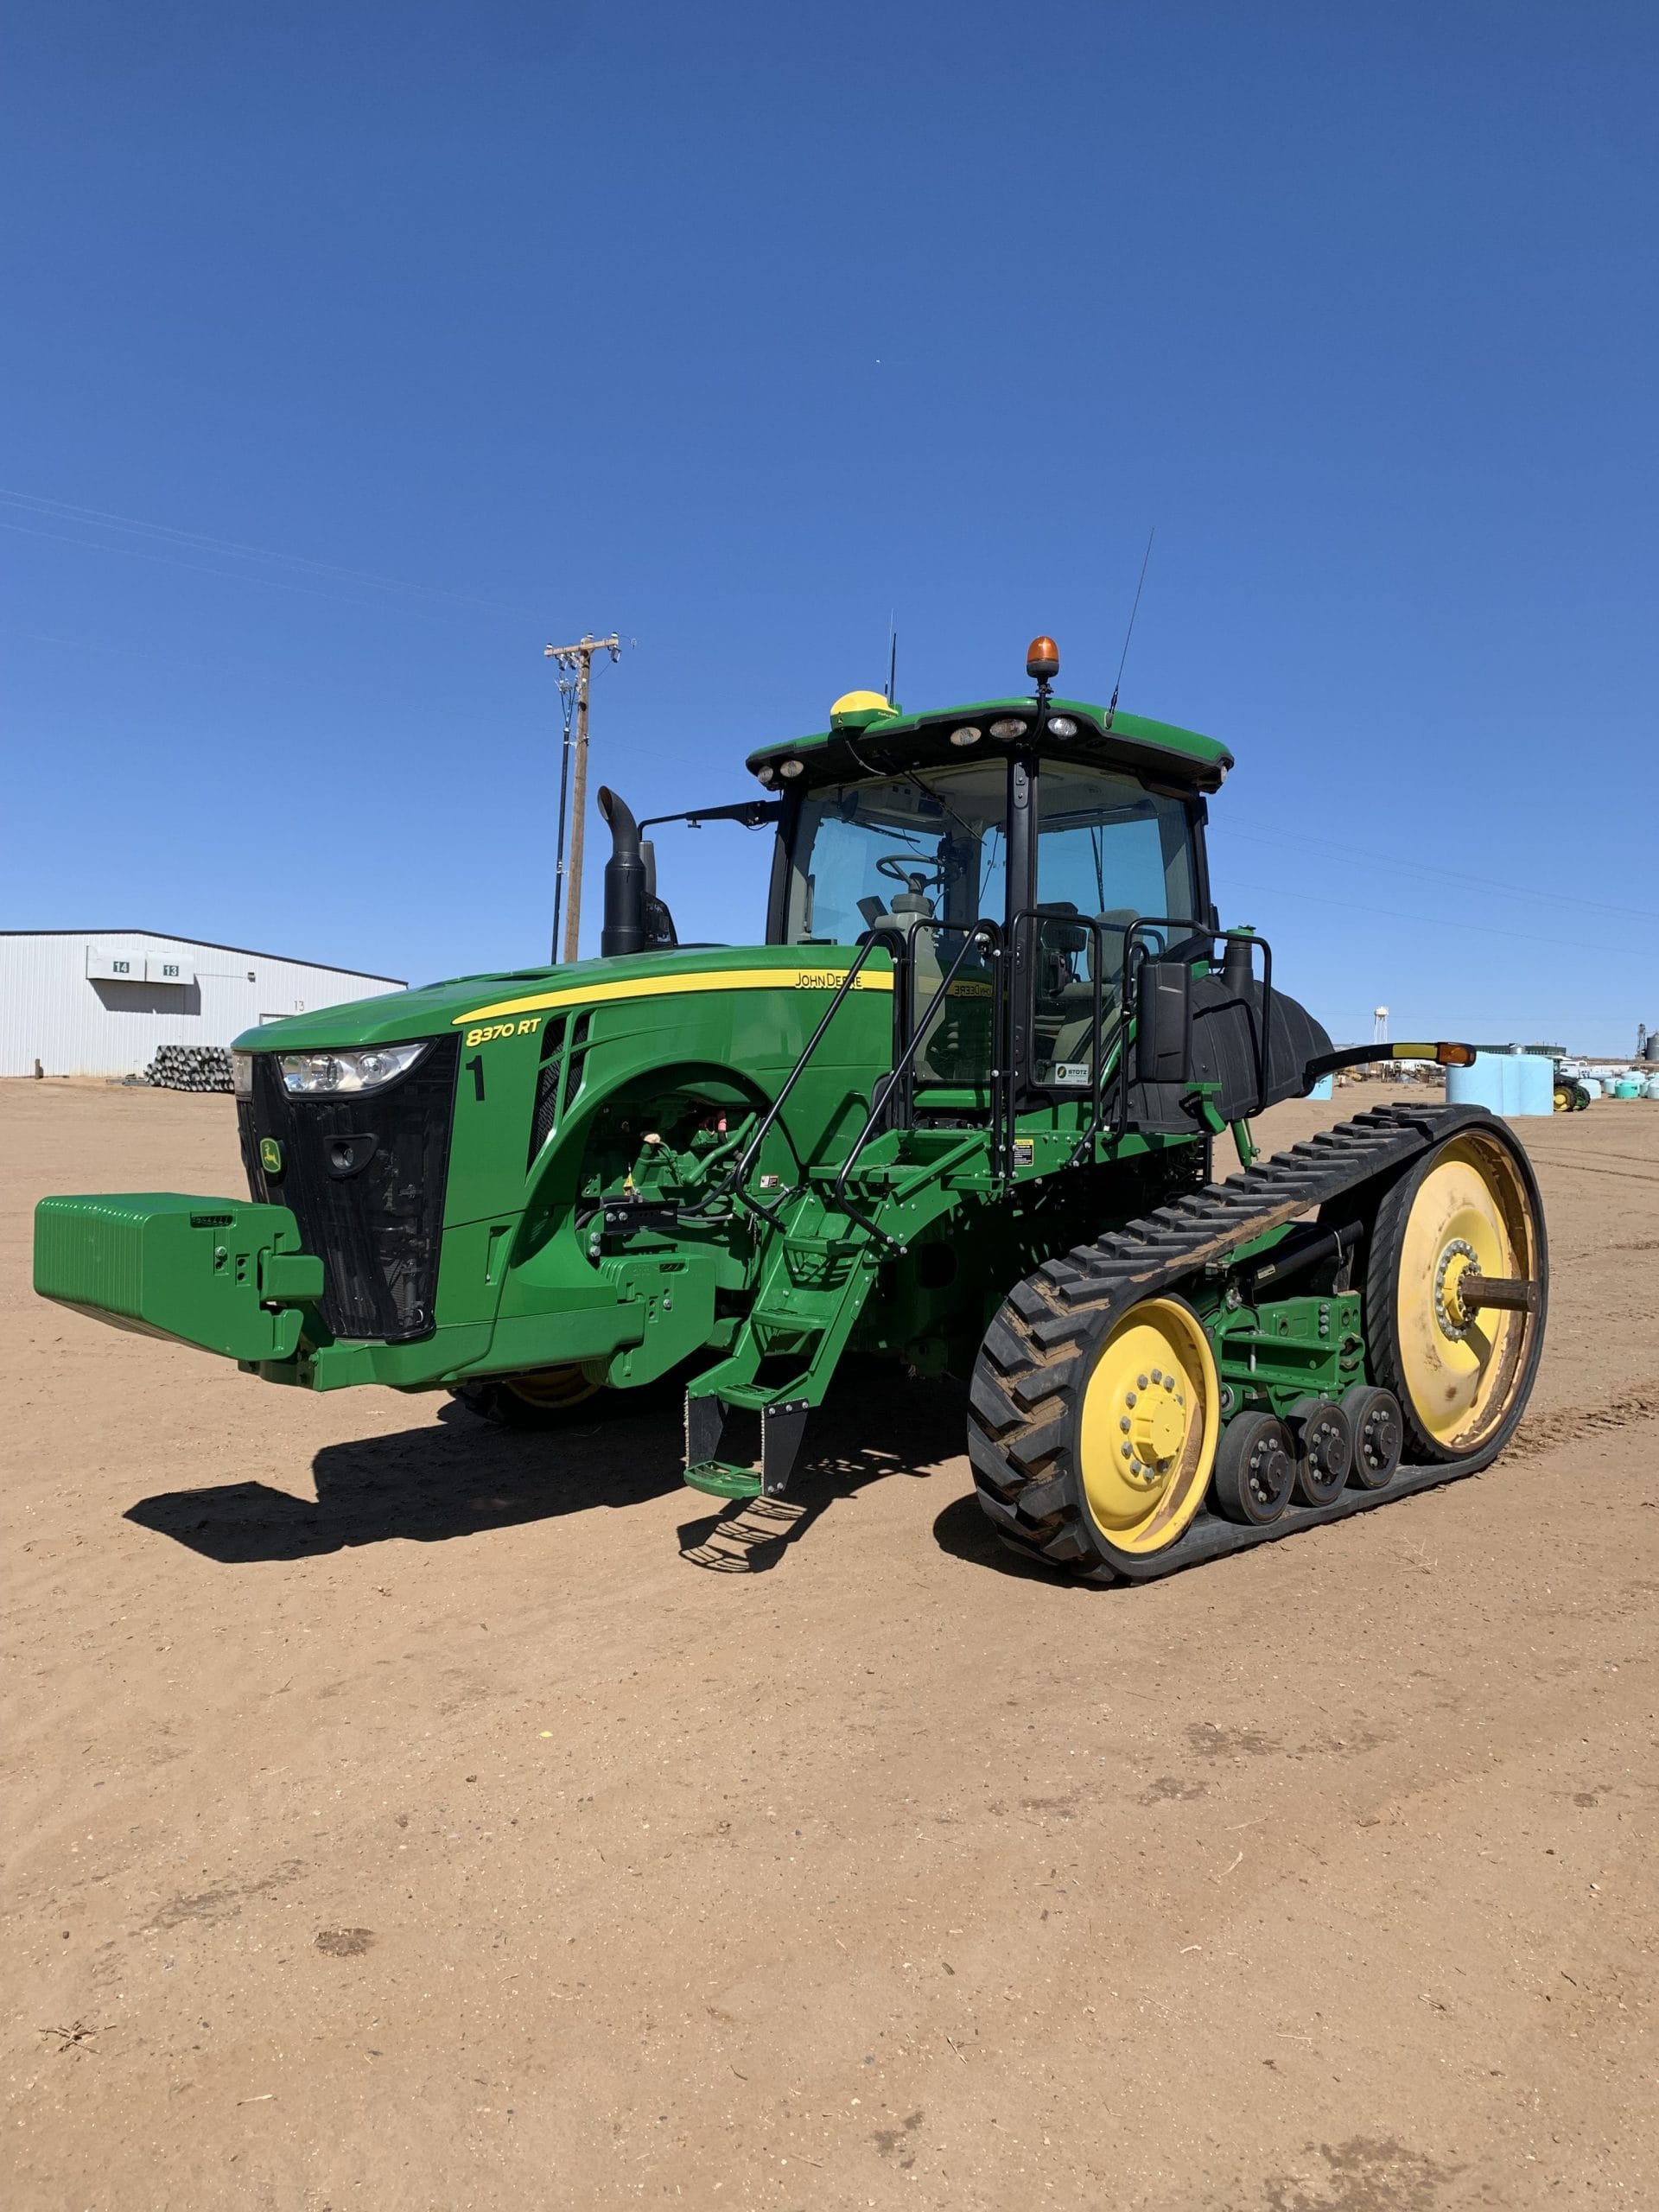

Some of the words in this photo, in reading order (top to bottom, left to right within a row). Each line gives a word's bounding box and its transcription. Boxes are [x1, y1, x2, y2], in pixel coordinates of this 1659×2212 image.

[114, 963, 128, 972] 14
[164, 966, 177, 976] 13
[796, 971, 825, 987] JOHN
[294, 1001, 305, 1012] 13
[466, 1023, 515, 1047] 8370
[518, 1017, 542, 1036] RT
[466, 1055, 485, 1101] 1
